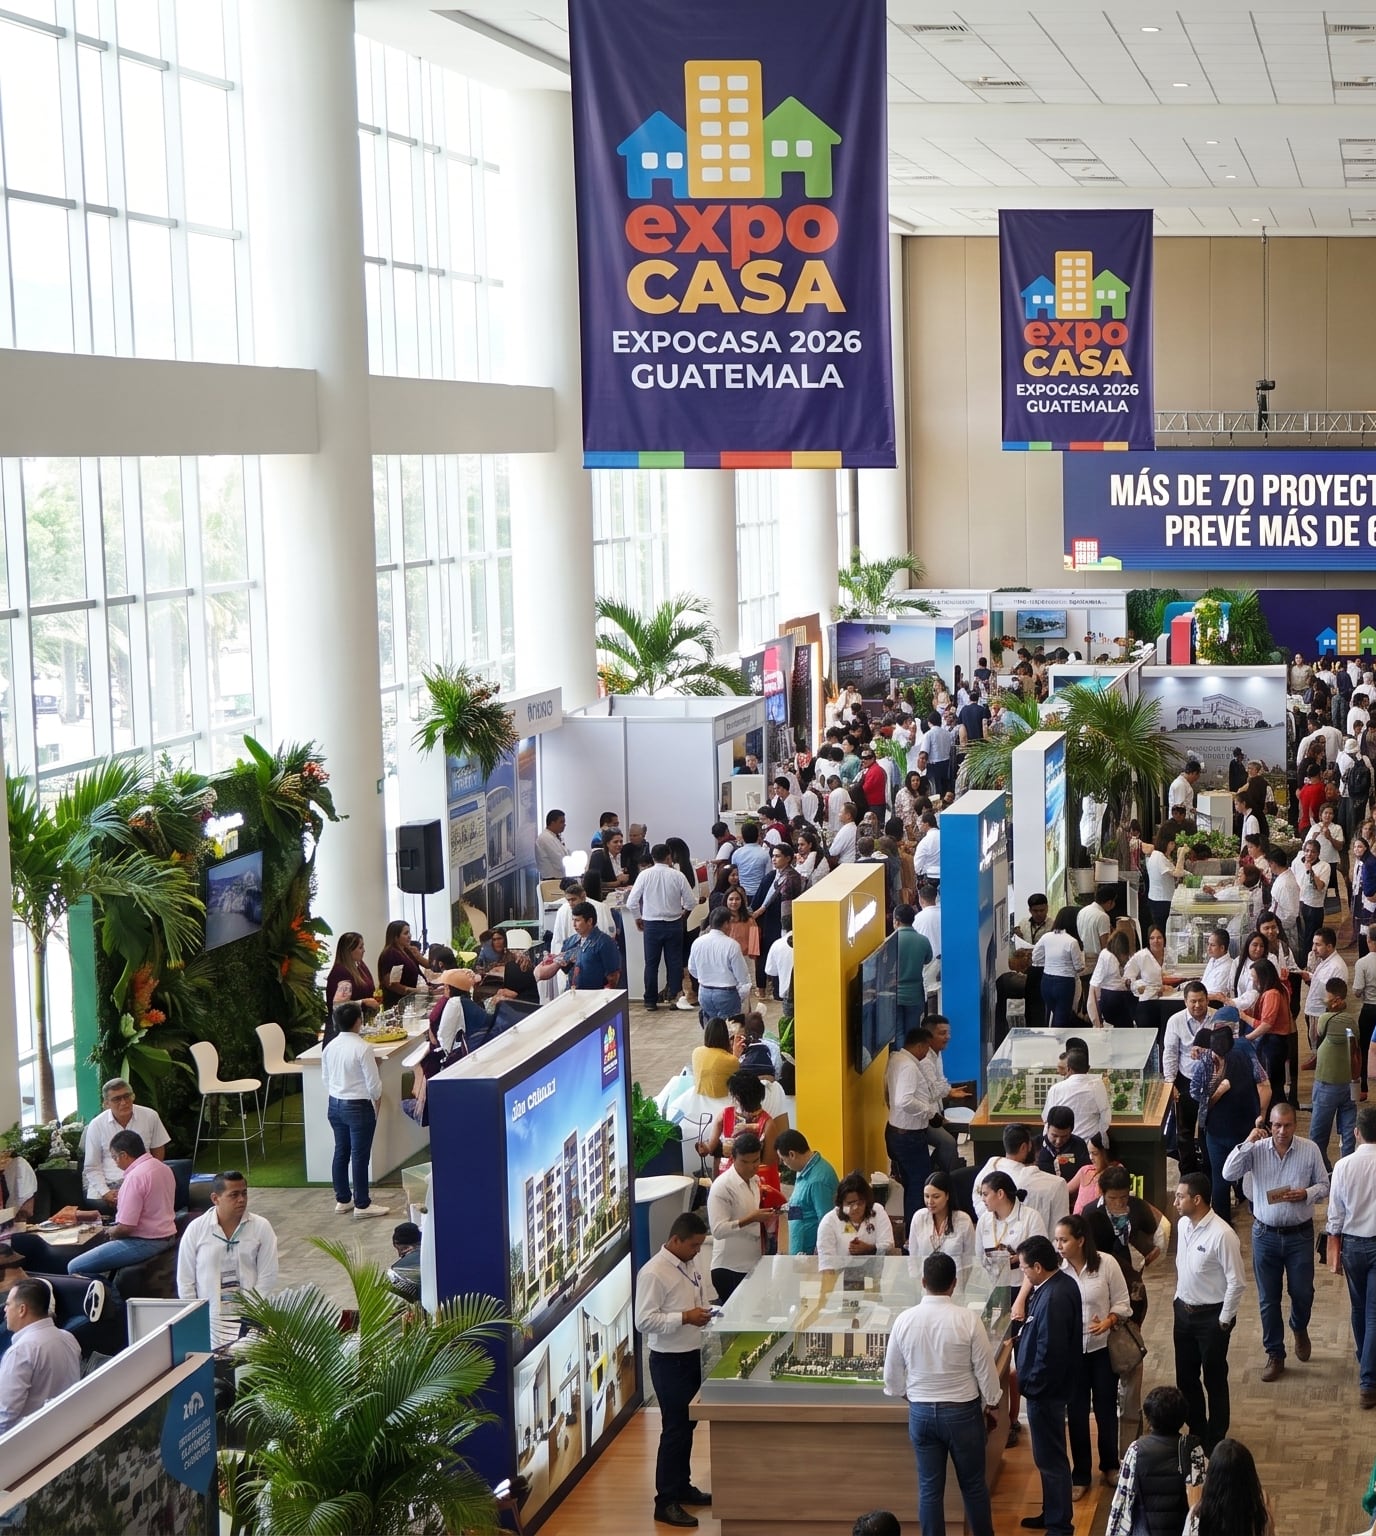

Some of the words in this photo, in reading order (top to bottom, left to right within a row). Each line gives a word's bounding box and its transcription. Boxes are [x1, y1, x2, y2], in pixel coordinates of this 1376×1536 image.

[624, 204, 839, 270] expo
[626, 259, 846, 315] CASA
[612, 329, 782, 354] EXPOCASA
[789, 329, 863, 354] 2026
[1023, 321, 1129, 355] expo
[630, 363, 845, 390] GUATEMALA
[1023, 348, 1132, 377] CASA
[1016, 383, 1100, 397] EXPOCASA
[1102, 383, 1140, 397] 2026
[1026, 399, 1130, 414] GUATEMALA
[1110, 466, 1170, 507] MÁS
[1177, 474, 1212, 507] DE
[1219, 473, 1255, 507] 70
[1165, 508, 1251, 547] PREVÉ
[1259, 508, 1318, 547] MÁS
[1325, 514, 1360, 547] DE
